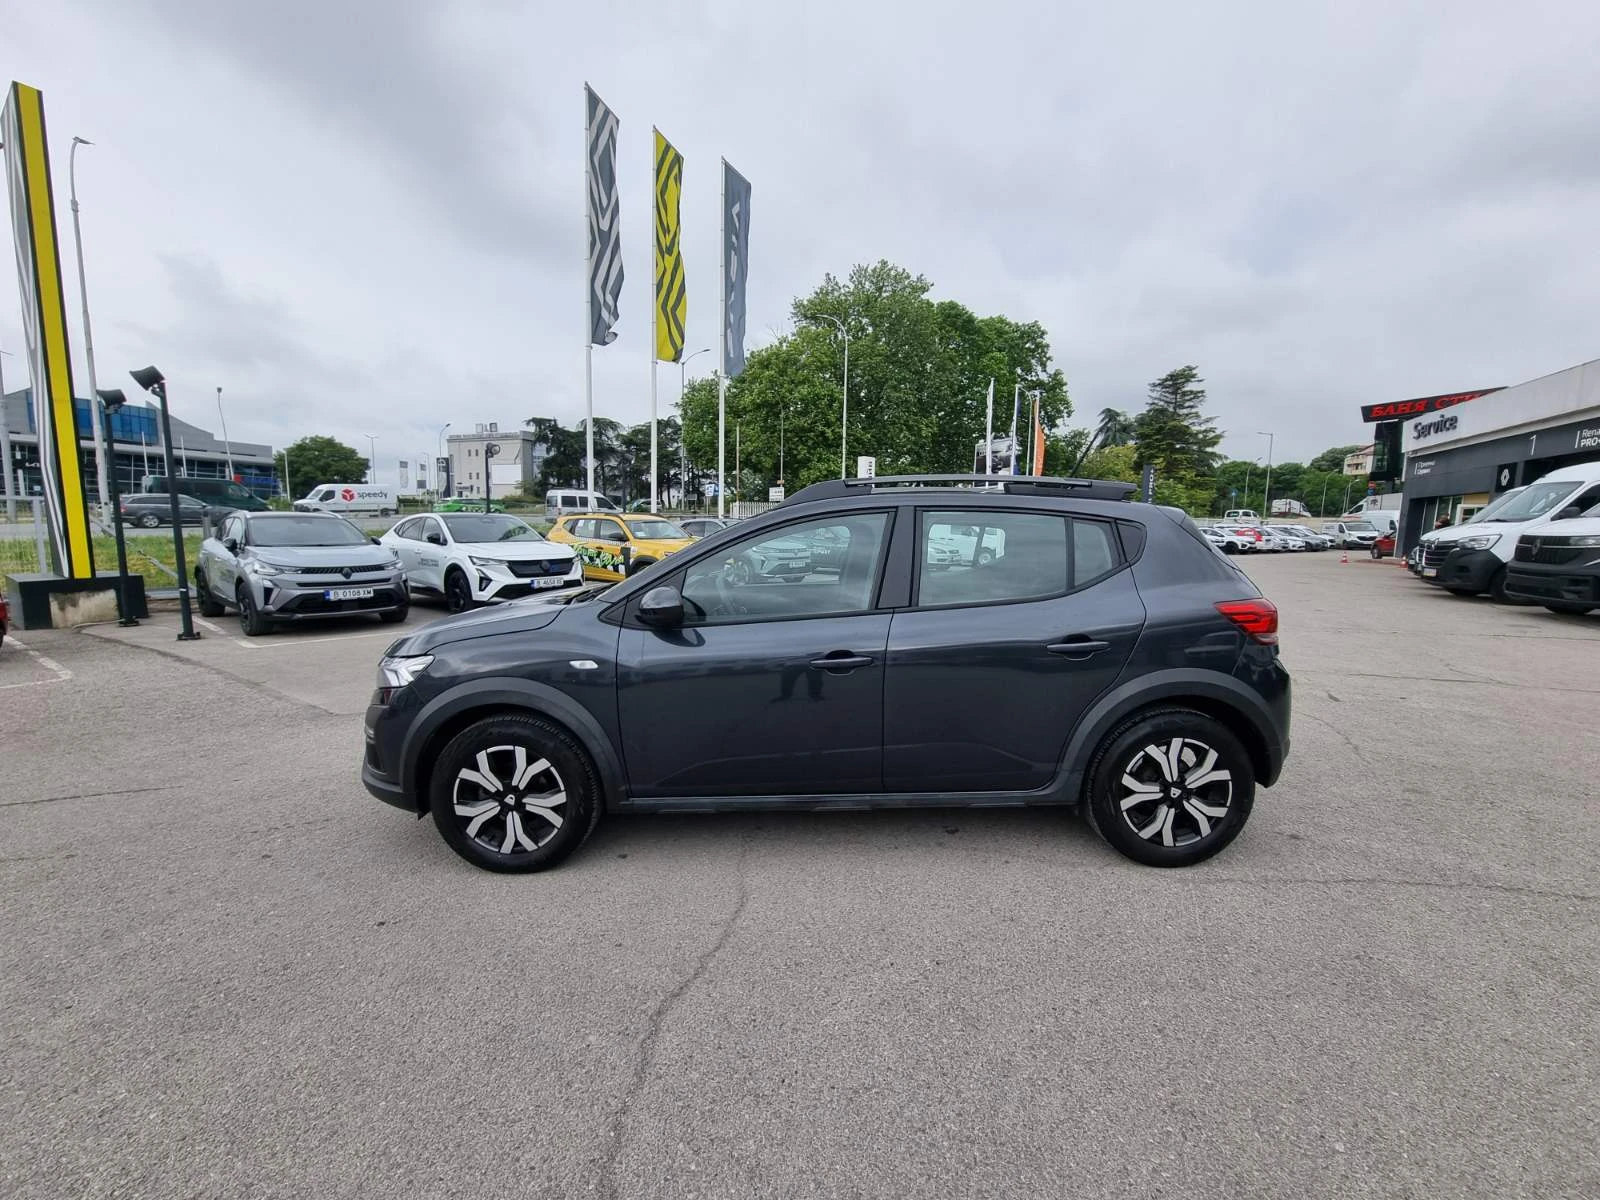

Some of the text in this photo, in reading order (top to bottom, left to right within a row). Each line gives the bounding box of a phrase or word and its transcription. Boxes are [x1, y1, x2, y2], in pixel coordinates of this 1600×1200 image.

[1371, 399, 1428, 417] БАНЯ
[1413, 414, 1458, 440] Service
[1529, 434, 1537, 456] 1
[357, 491, 388, 499] speedy
